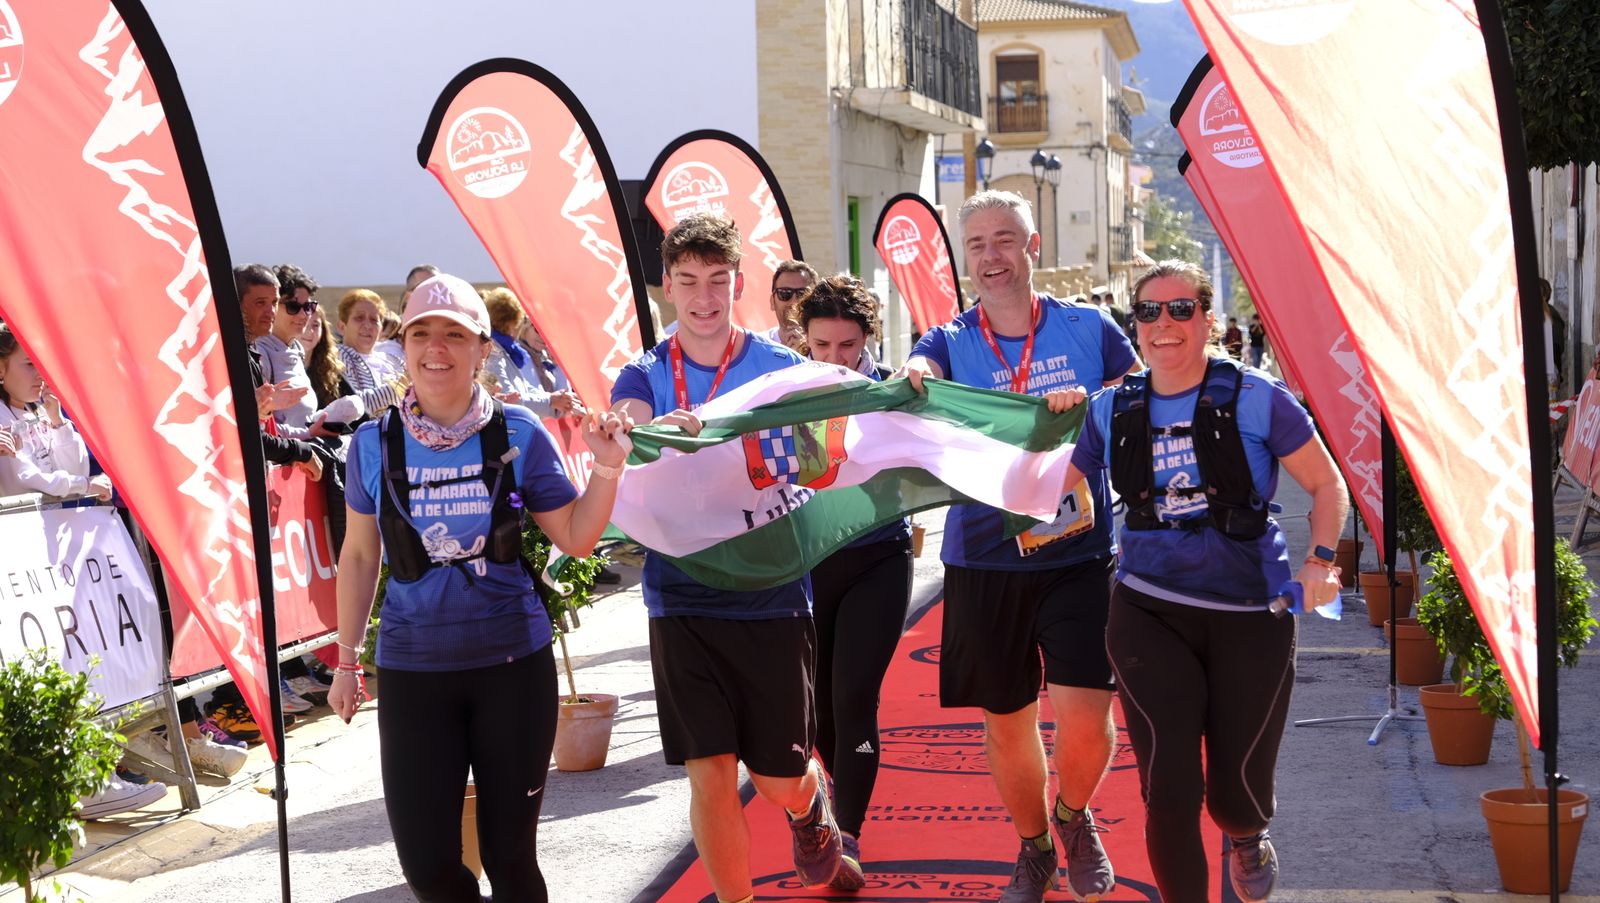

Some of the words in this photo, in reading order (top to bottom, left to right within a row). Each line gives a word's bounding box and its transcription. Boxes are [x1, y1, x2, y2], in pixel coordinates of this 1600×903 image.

[425, 503, 442, 517] DE
[86, 555, 122, 584] DE
[0, 593, 142, 667] ORIA
